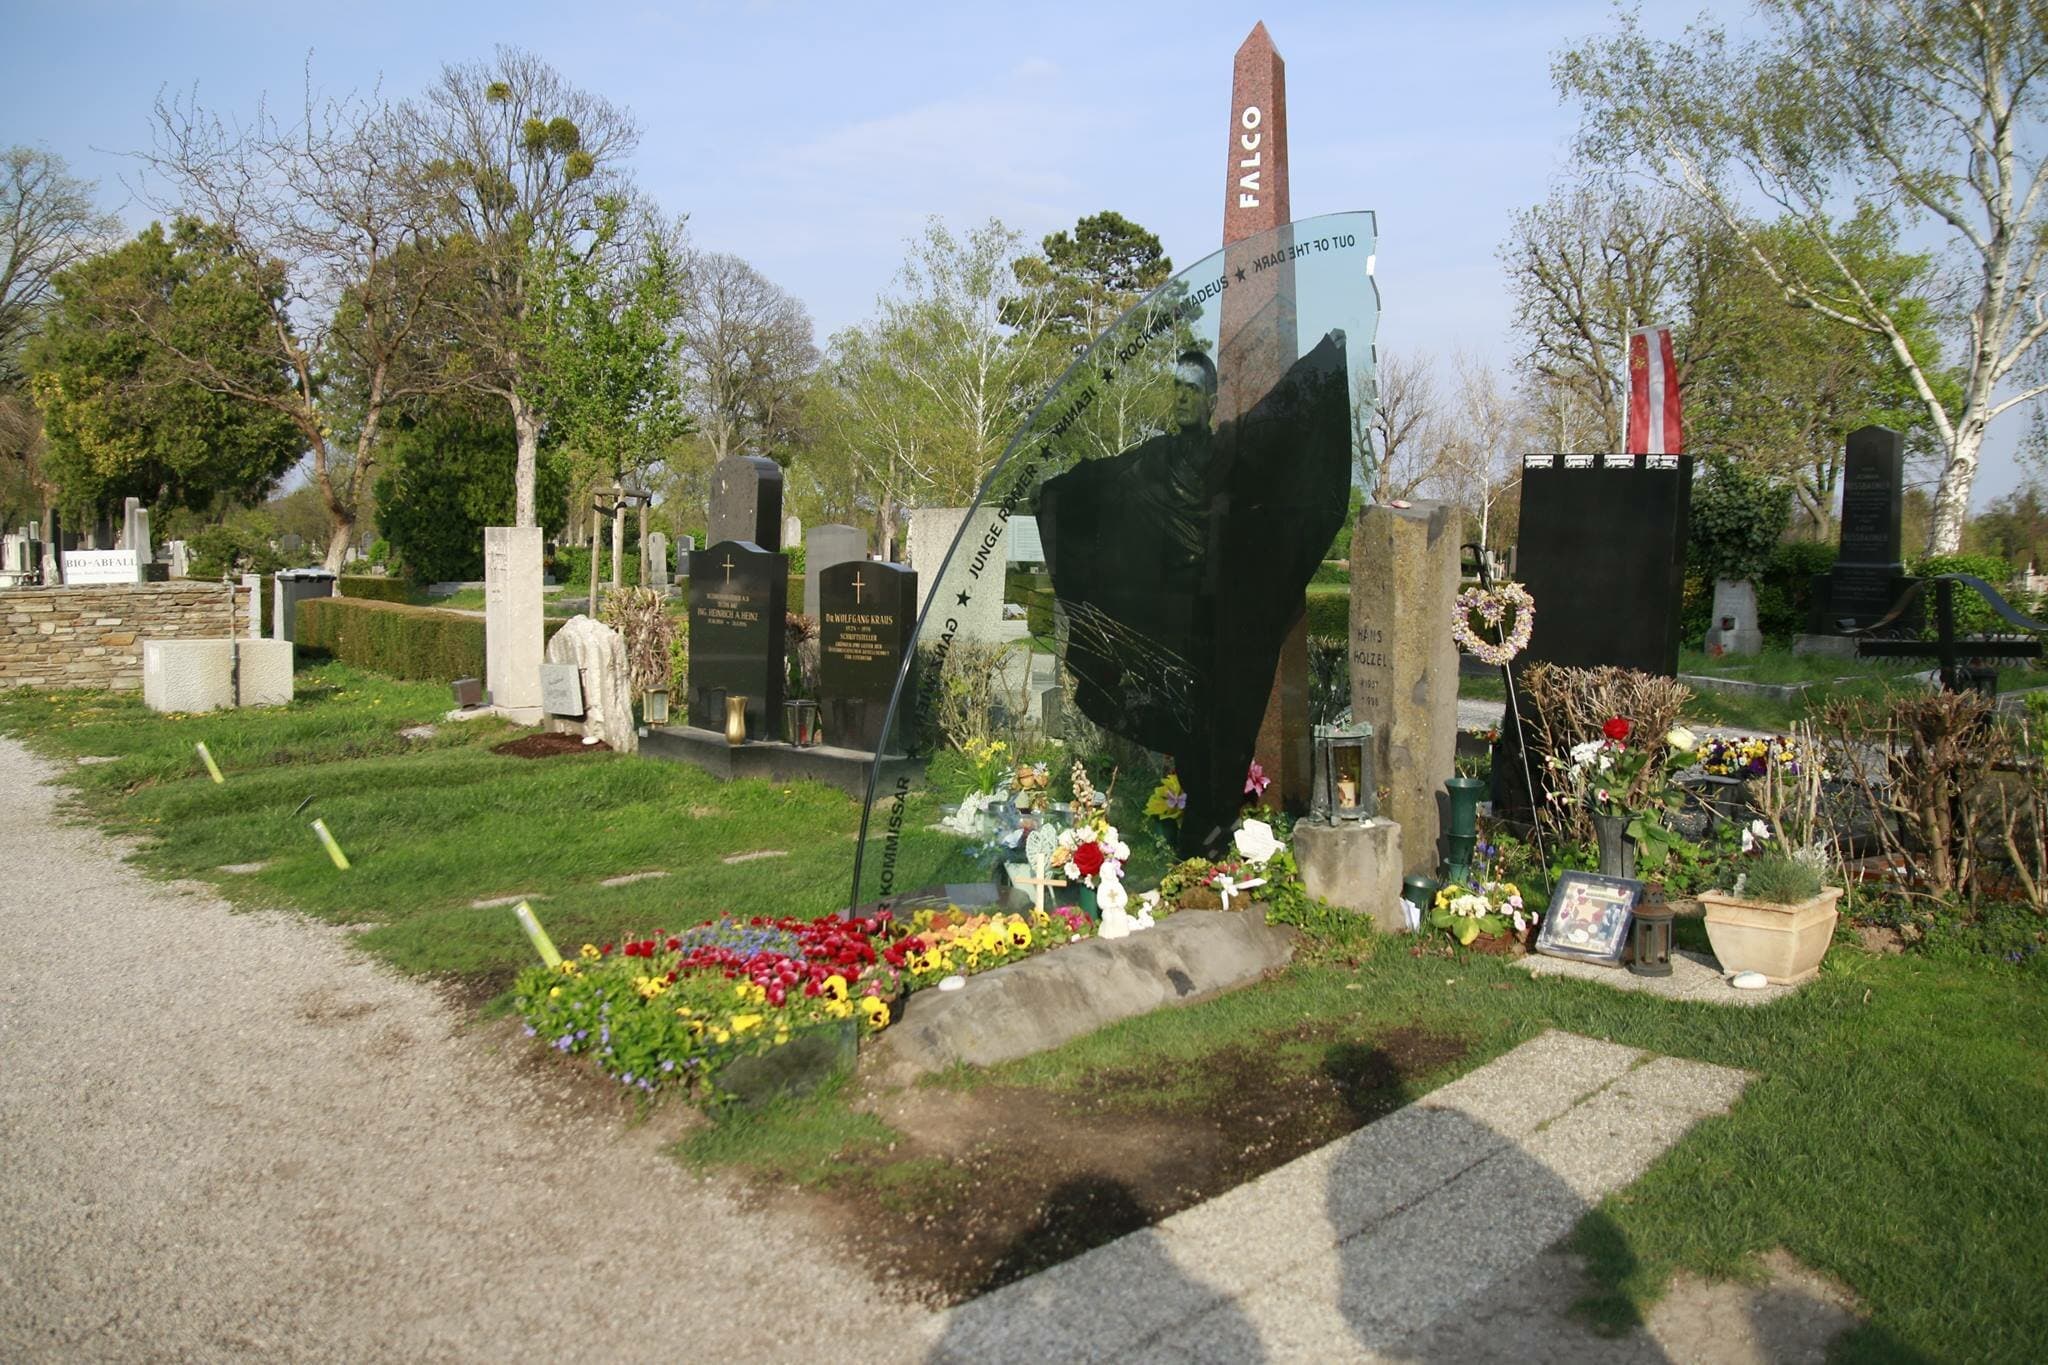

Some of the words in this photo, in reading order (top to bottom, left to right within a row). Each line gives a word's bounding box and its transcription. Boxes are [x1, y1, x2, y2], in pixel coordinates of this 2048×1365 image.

[1239, 106, 1262, 208] FALCO
[1118, 329, 1154, 365] ROCK
[1175, 275, 1229, 320] AMADEUS
[66, 557, 137, 568] BIO-ABFALL
[969, 523, 1003, 580] JUNGE
[870, 615, 893, 625] KRAUS
[879, 776, 911, 896] KOMMISSAR
